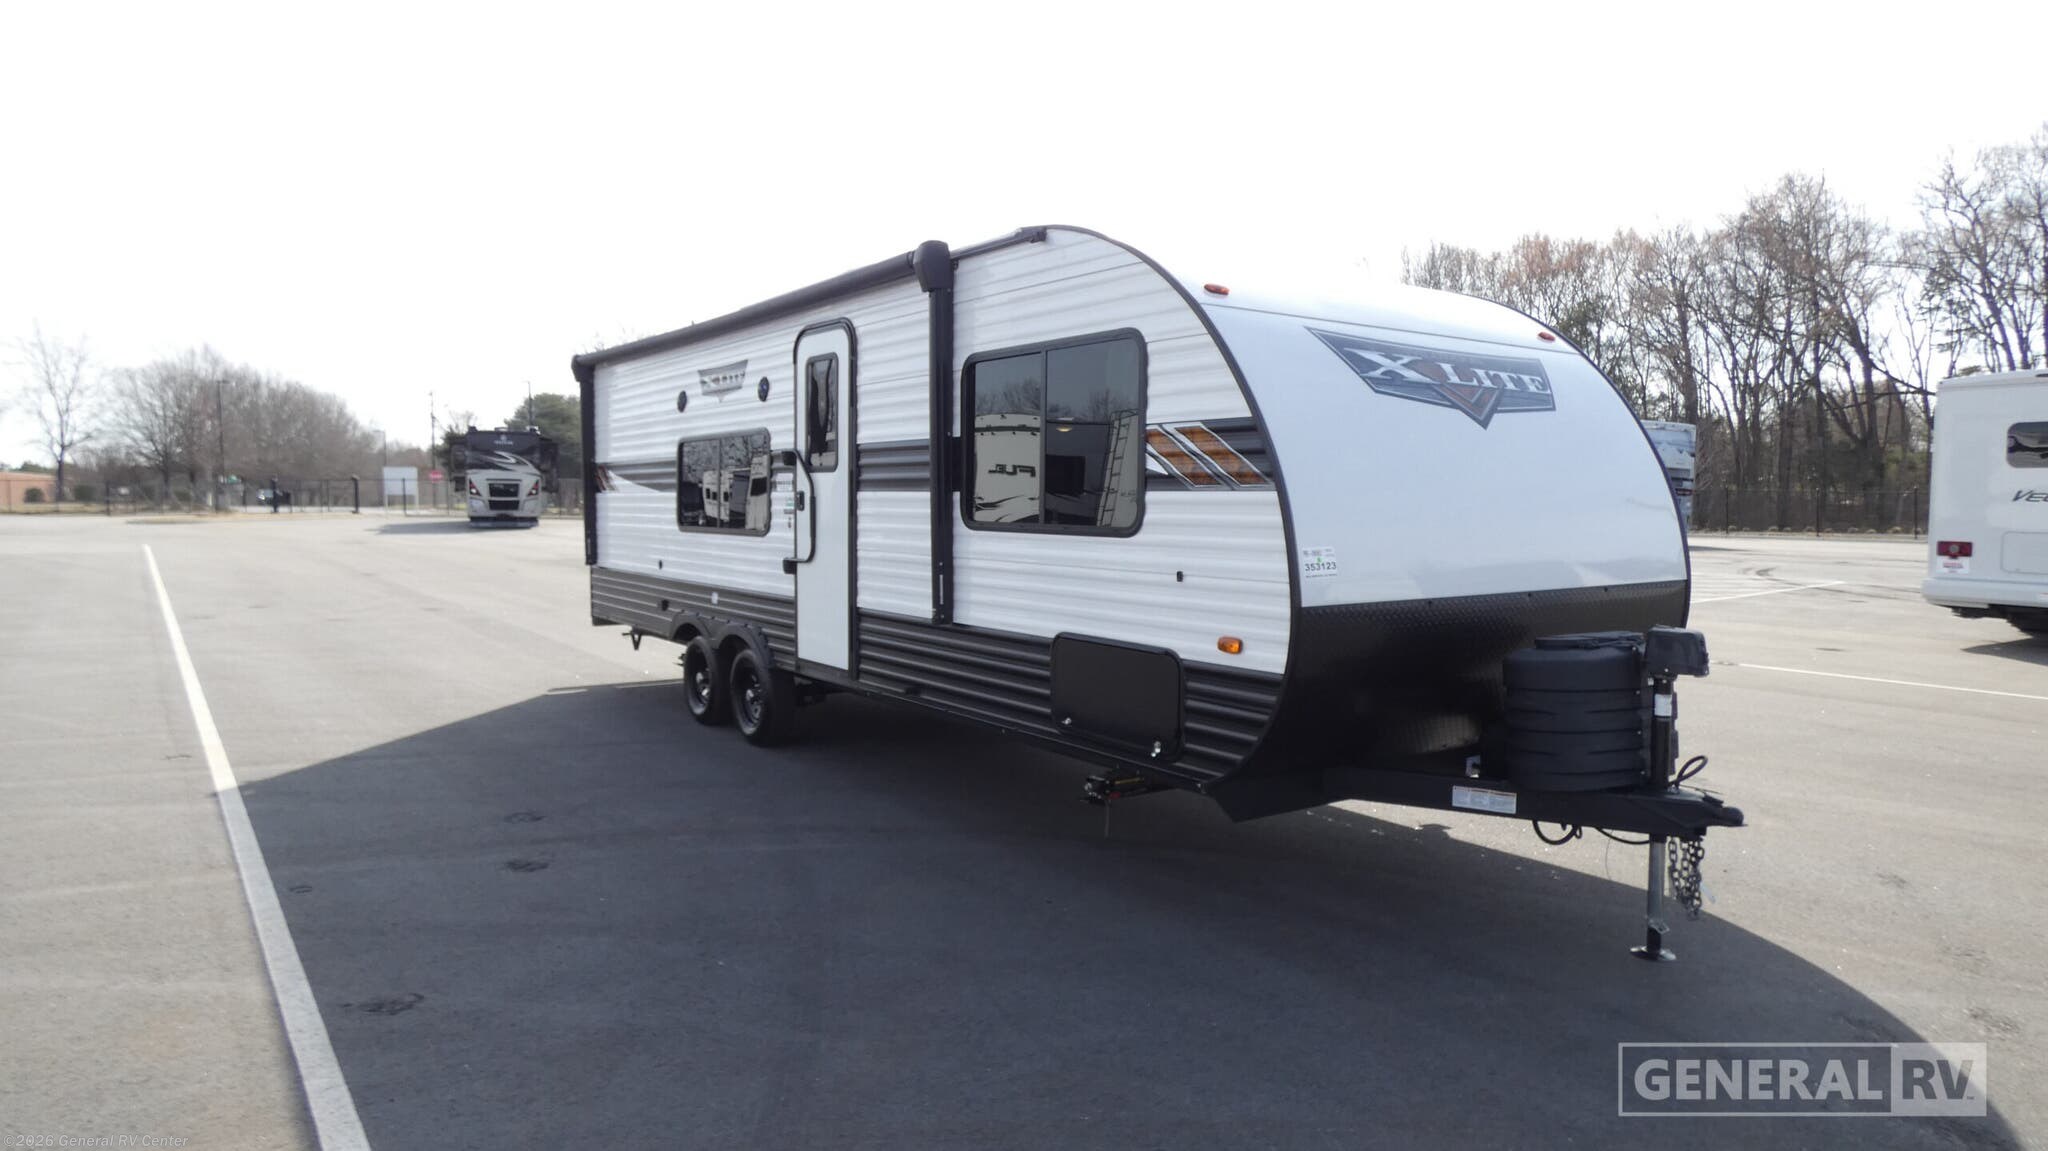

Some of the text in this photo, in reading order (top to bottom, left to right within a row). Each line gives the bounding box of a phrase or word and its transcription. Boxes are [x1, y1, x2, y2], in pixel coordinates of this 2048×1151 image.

[1343, 348, 1551, 394] X LITE
[2012, 489, 2048, 503] VE
[1304, 561, 1337, 571] 353123
